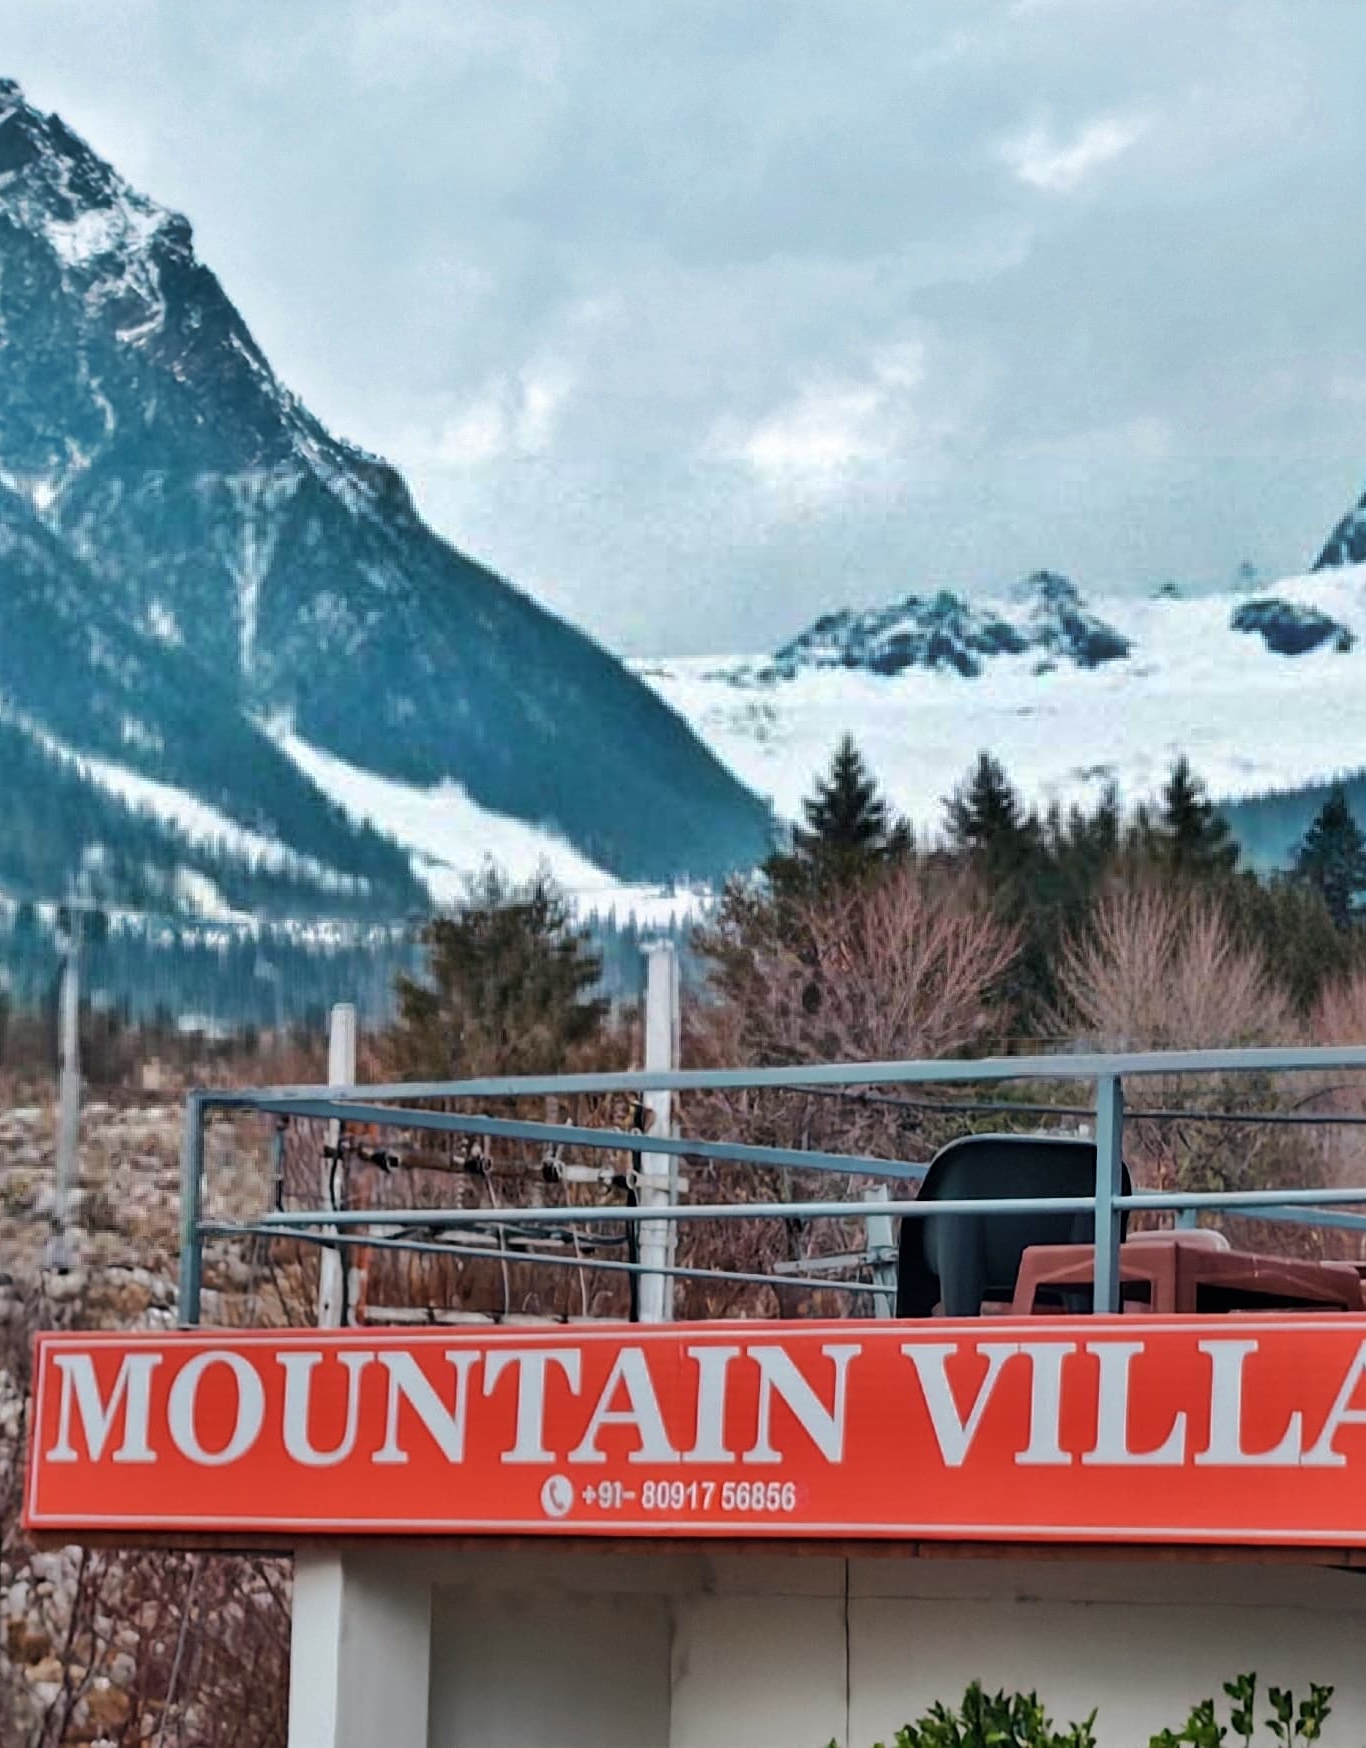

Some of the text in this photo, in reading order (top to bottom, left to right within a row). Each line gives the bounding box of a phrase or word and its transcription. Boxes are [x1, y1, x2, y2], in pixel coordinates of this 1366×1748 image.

[44, 1342, 863, 1466] MOUNTAIN
[581, 1481, 797, 1512] +91- 80917 56856
